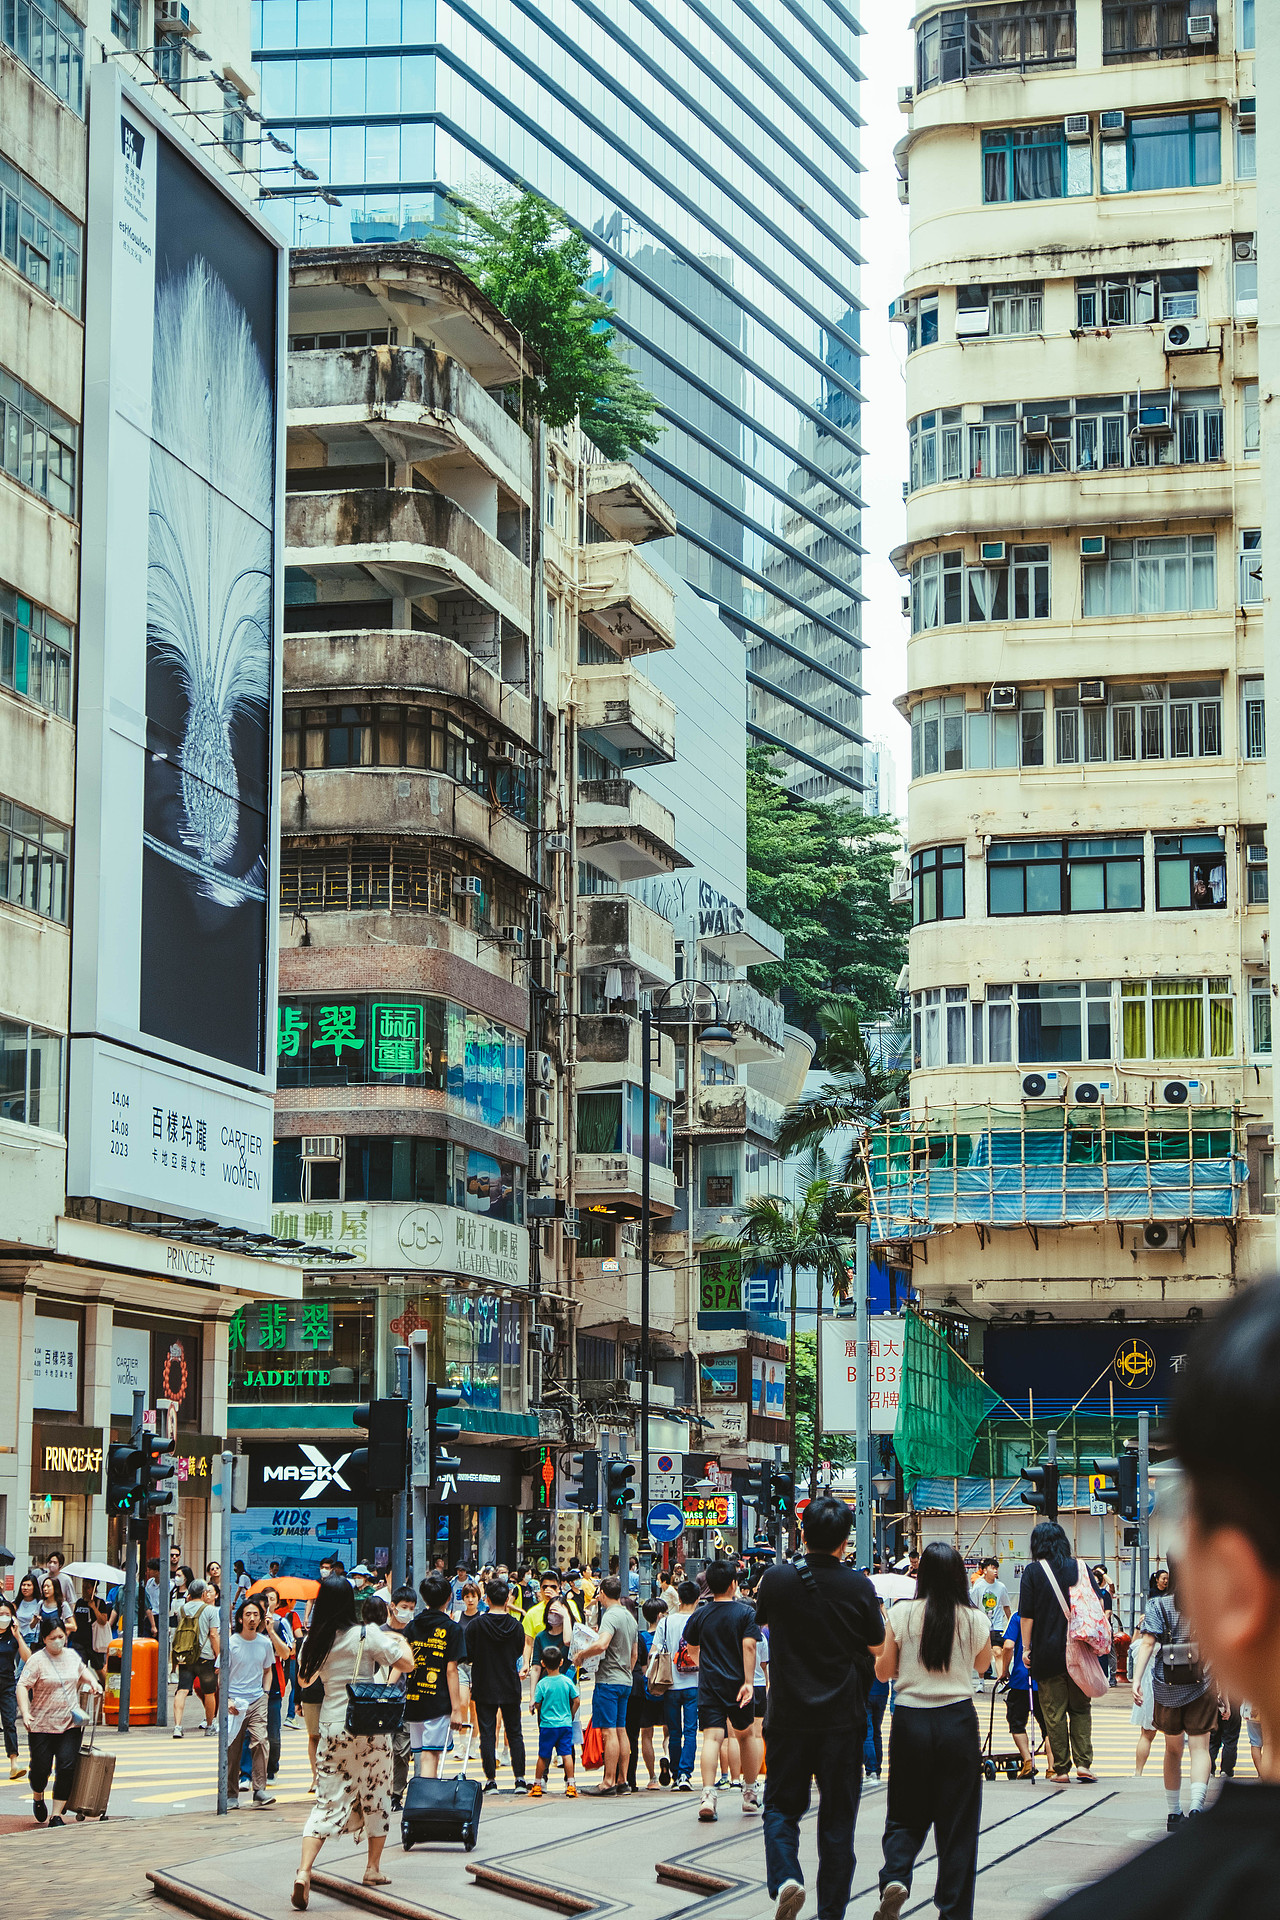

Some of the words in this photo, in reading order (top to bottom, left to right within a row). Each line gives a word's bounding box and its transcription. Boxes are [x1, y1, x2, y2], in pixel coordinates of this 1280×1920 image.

[277, 1005, 365, 1057] 翡翠
[111, 1091, 130, 1109] 14.04
[111, 1119, 129, 1137] 14.08
[152, 1106, 207, 1152] 百樣玲瓏
[110, 1140, 129, 1157] 2023
[220, 1126, 263, 1156] CARTIER
[238, 1144, 248, 1170] &
[222, 1162, 261, 1191] WOMEN
[495, 1259, 518, 1282] MESS
[702, 1284, 740, 1308] SPA
[844, 1340, 906, 1358] 麗園大
[116, 1356, 139, 1368] CARTIER
[117, 1374, 138, 1385] WOMEN
[243, 1370, 331, 1387] JADEITE
[263, 1466, 333, 1483] MASK
[669, 1476, 676, 1484] 7
[670, 1489, 681, 1499] 12
[272, 1509, 311, 1526] KIDS
[682, 1511, 718, 1519] MASSGE
[272, 1527, 284, 1537] 3D
[286, 1527, 311, 1536] MASK
[433, 1627, 447, 1639] 30
